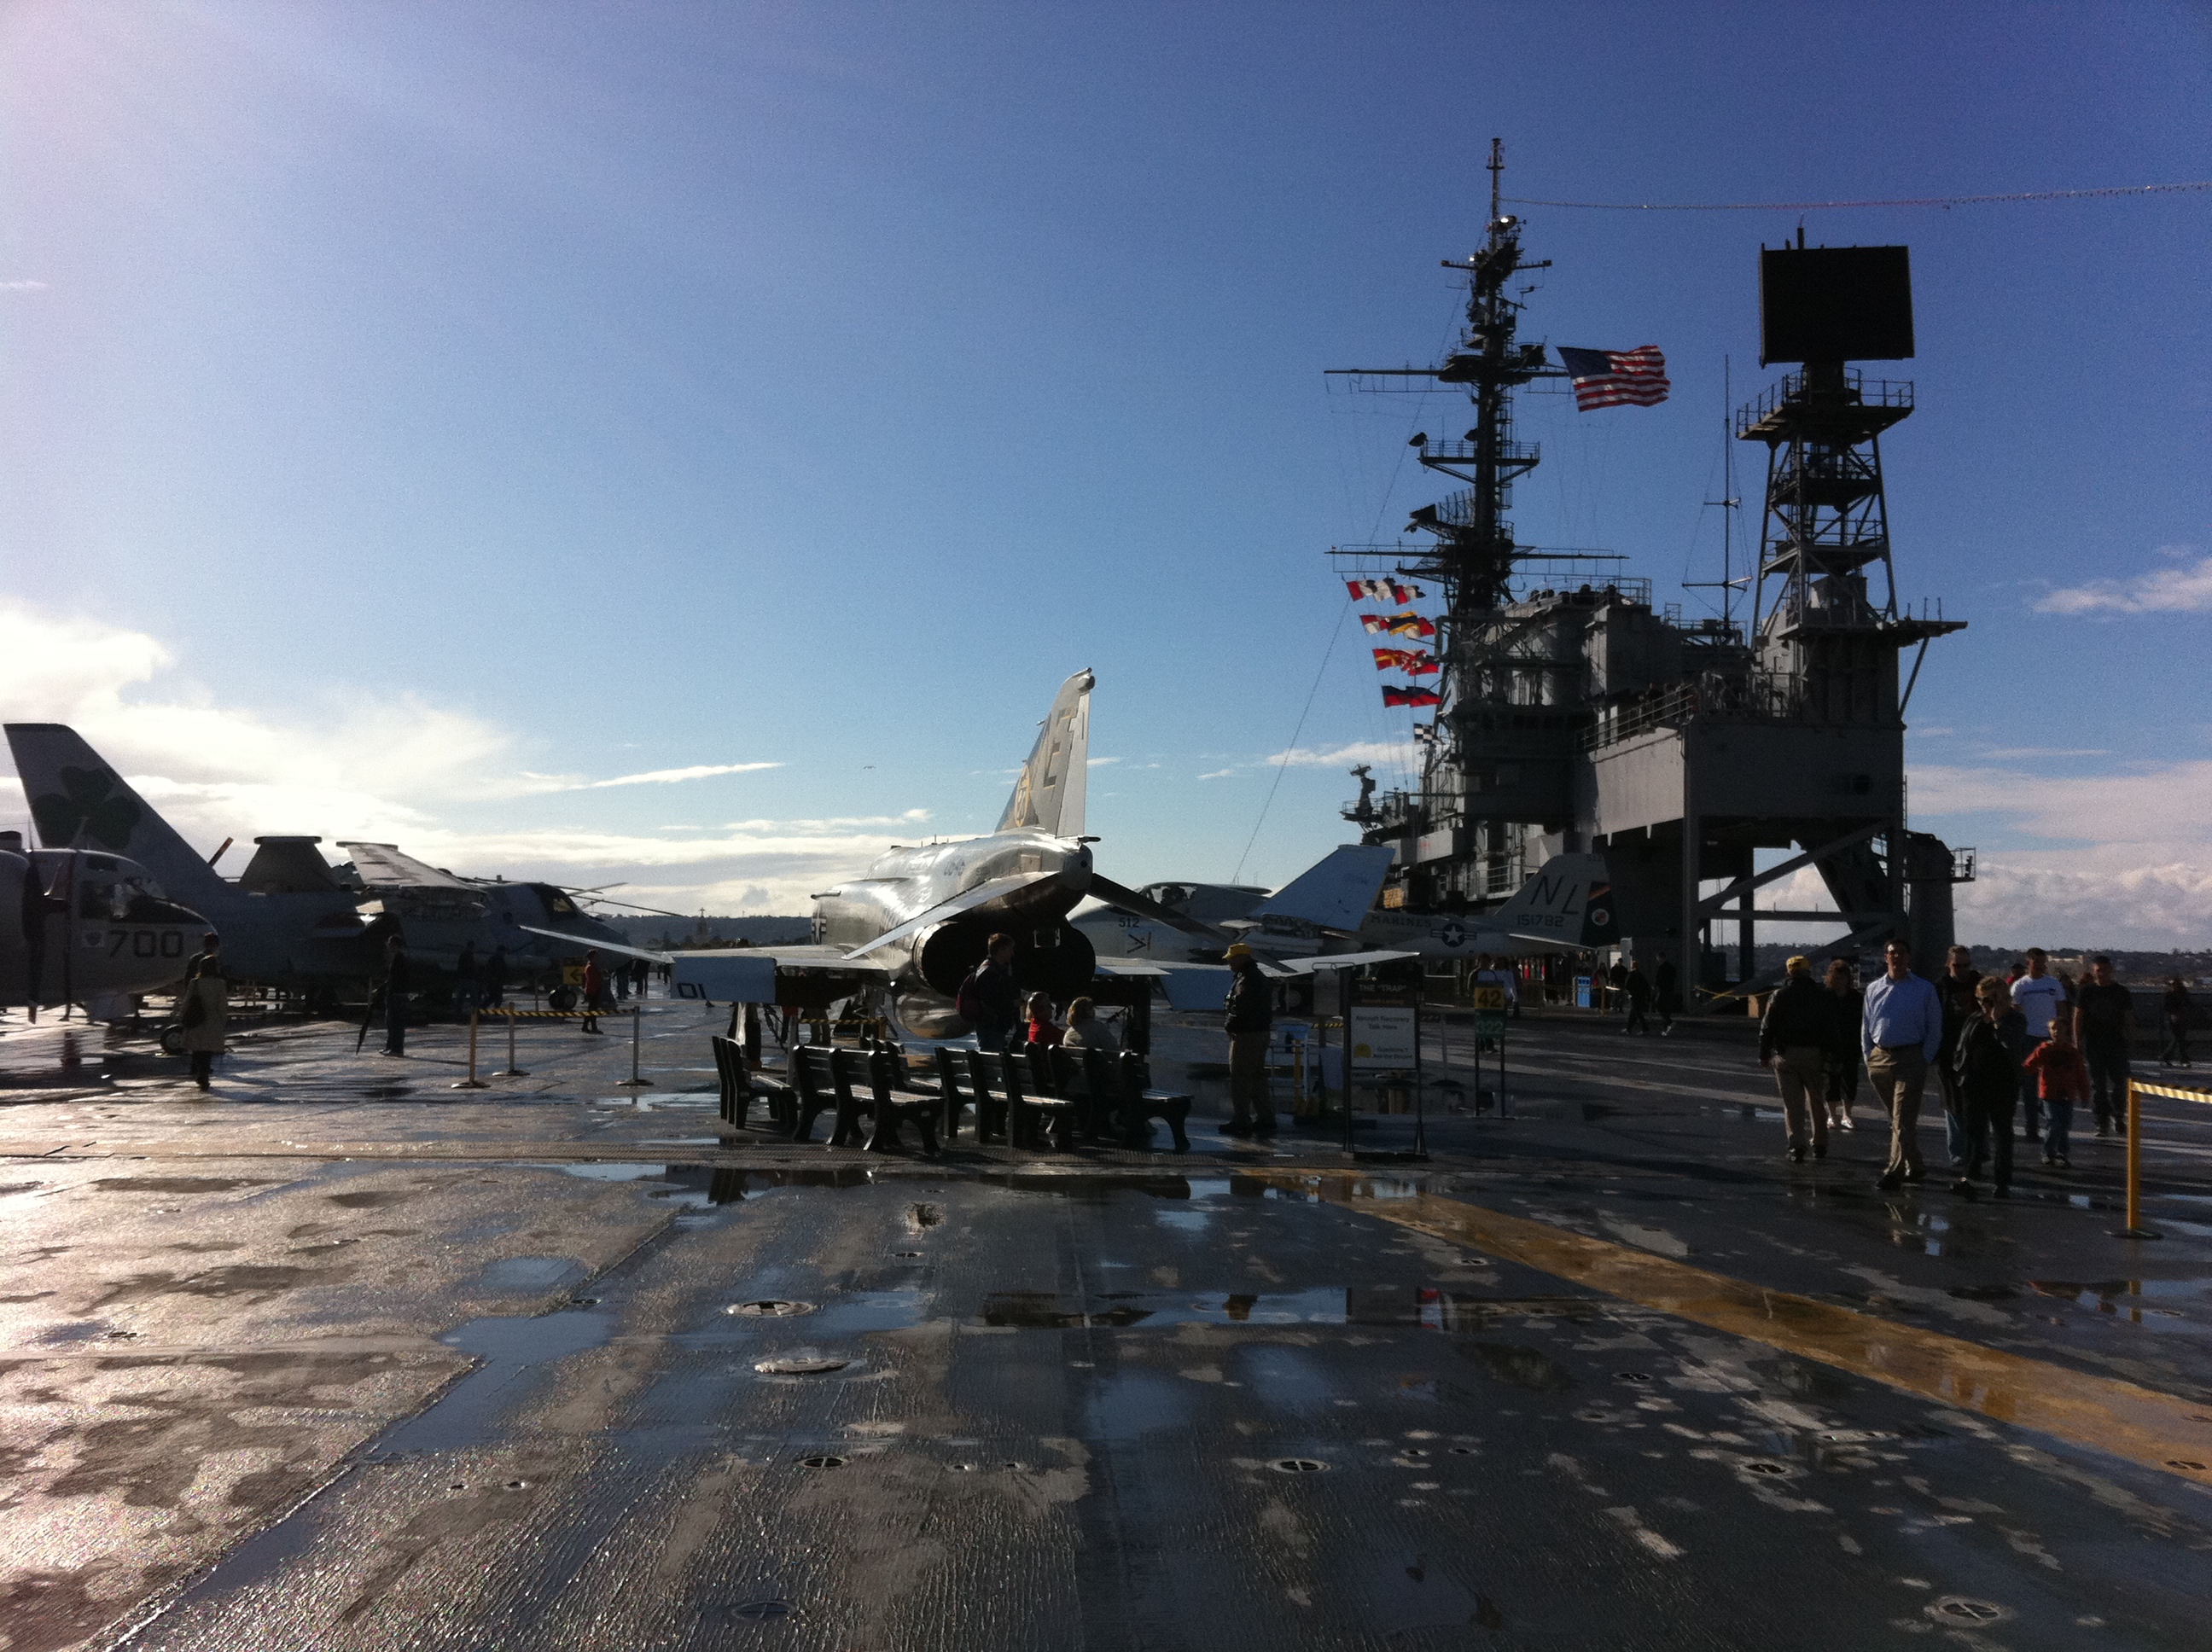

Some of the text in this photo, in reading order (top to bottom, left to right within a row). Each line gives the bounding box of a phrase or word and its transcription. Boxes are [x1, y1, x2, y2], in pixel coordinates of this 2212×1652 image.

[1118, 916, 1140, 928] 512
[1371, 914, 1432, 928] MARINES
[1517, 914, 1564, 928] 151782
[108, 929, 183, 957] 700
[1477, 990, 1502, 1008] 42
